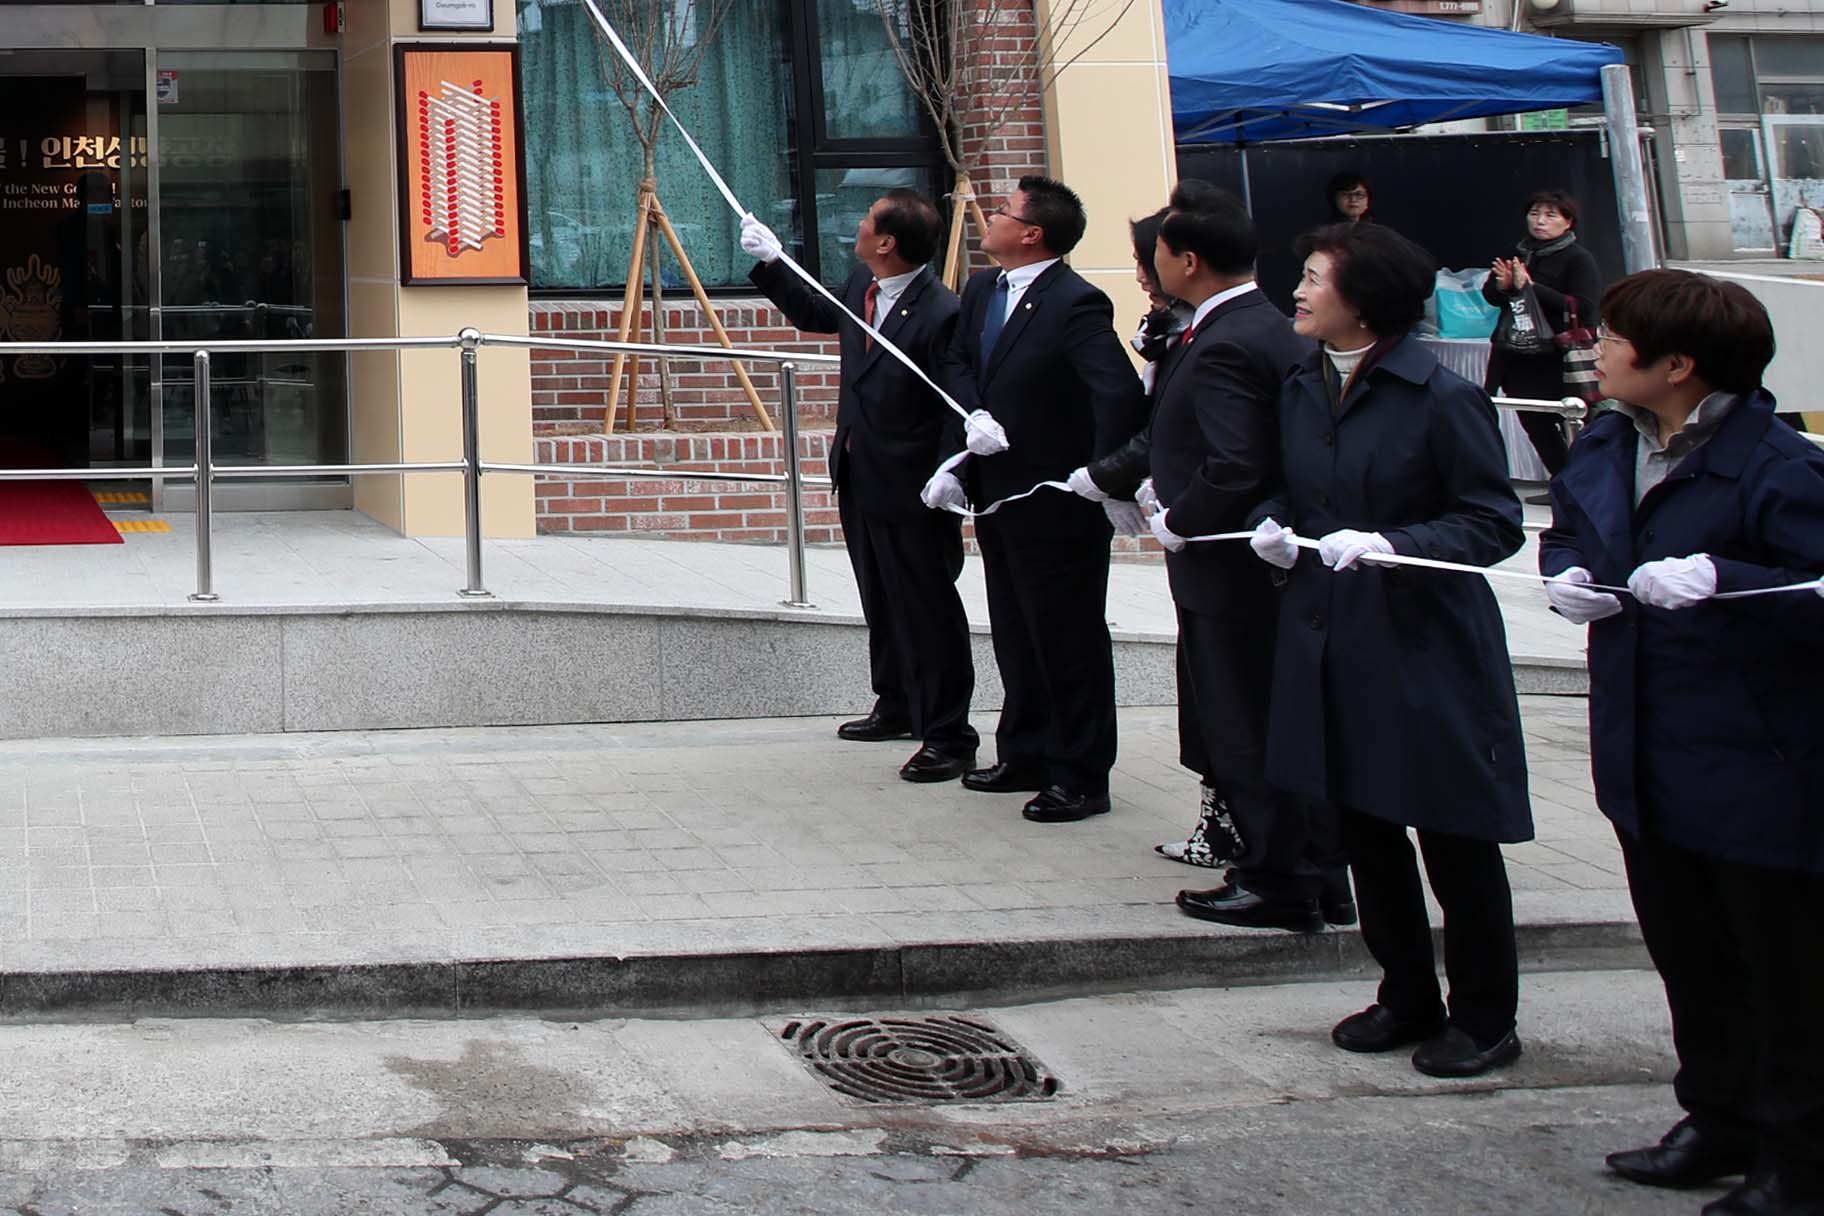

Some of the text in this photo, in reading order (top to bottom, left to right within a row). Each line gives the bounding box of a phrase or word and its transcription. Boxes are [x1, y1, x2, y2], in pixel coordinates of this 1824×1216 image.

[5, 183, 28, 196] the
[30, 183, 61, 196] New
[2, 197, 59, 211] Incheon
